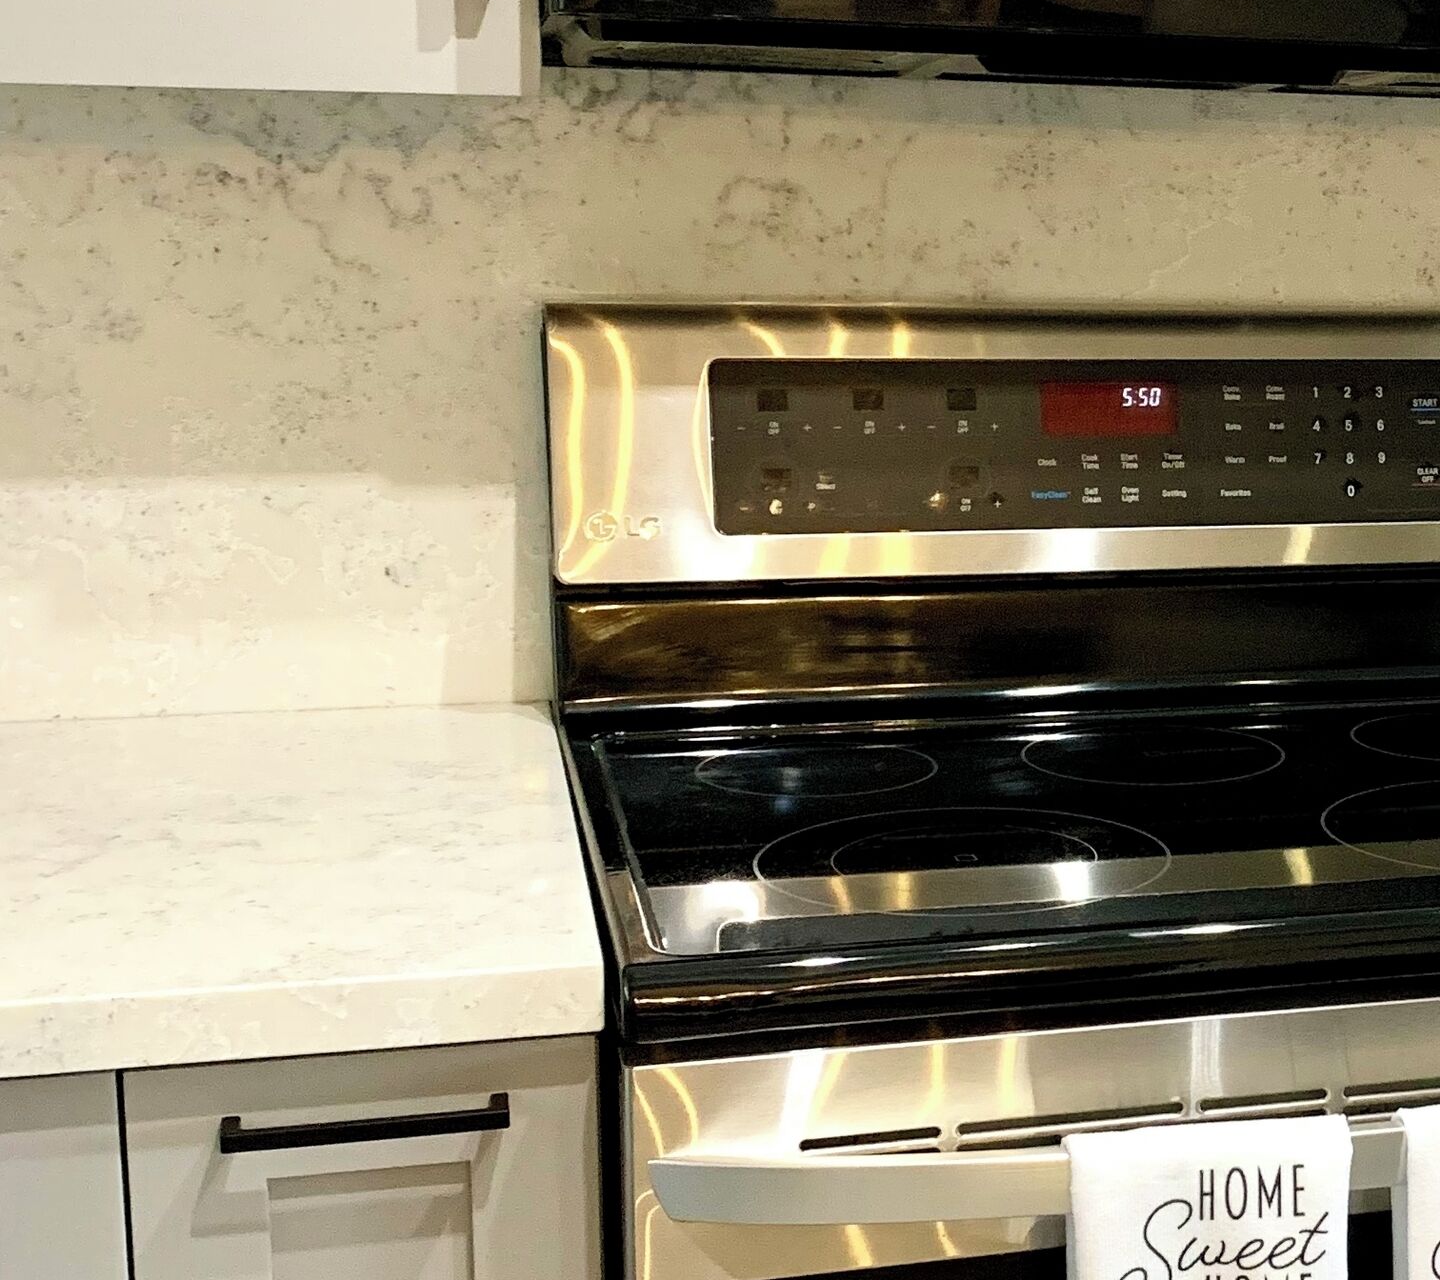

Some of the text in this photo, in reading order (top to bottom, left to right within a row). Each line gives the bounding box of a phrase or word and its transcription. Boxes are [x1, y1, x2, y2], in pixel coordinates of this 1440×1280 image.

[1122, 387, 1161, 407] 5:50
[1313, 386, 1319, 398] 1
[1343, 386, 1351, 398] 2
[1375, 386, 1383, 398] 3
[1412, 398, 1438, 407] START
[1312, 420, 1320, 431] 4
[1345, 420, 1353, 431] 5
[1376, 419, 1385, 431] 6
[1314, 453, 1321, 464] 7
[1346, 452, 1354, 464] 8
[1377, 452, 1386, 464] 9
[1347, 485, 1355, 497] 0
[1198, 1164, 1307, 1221] HOME
